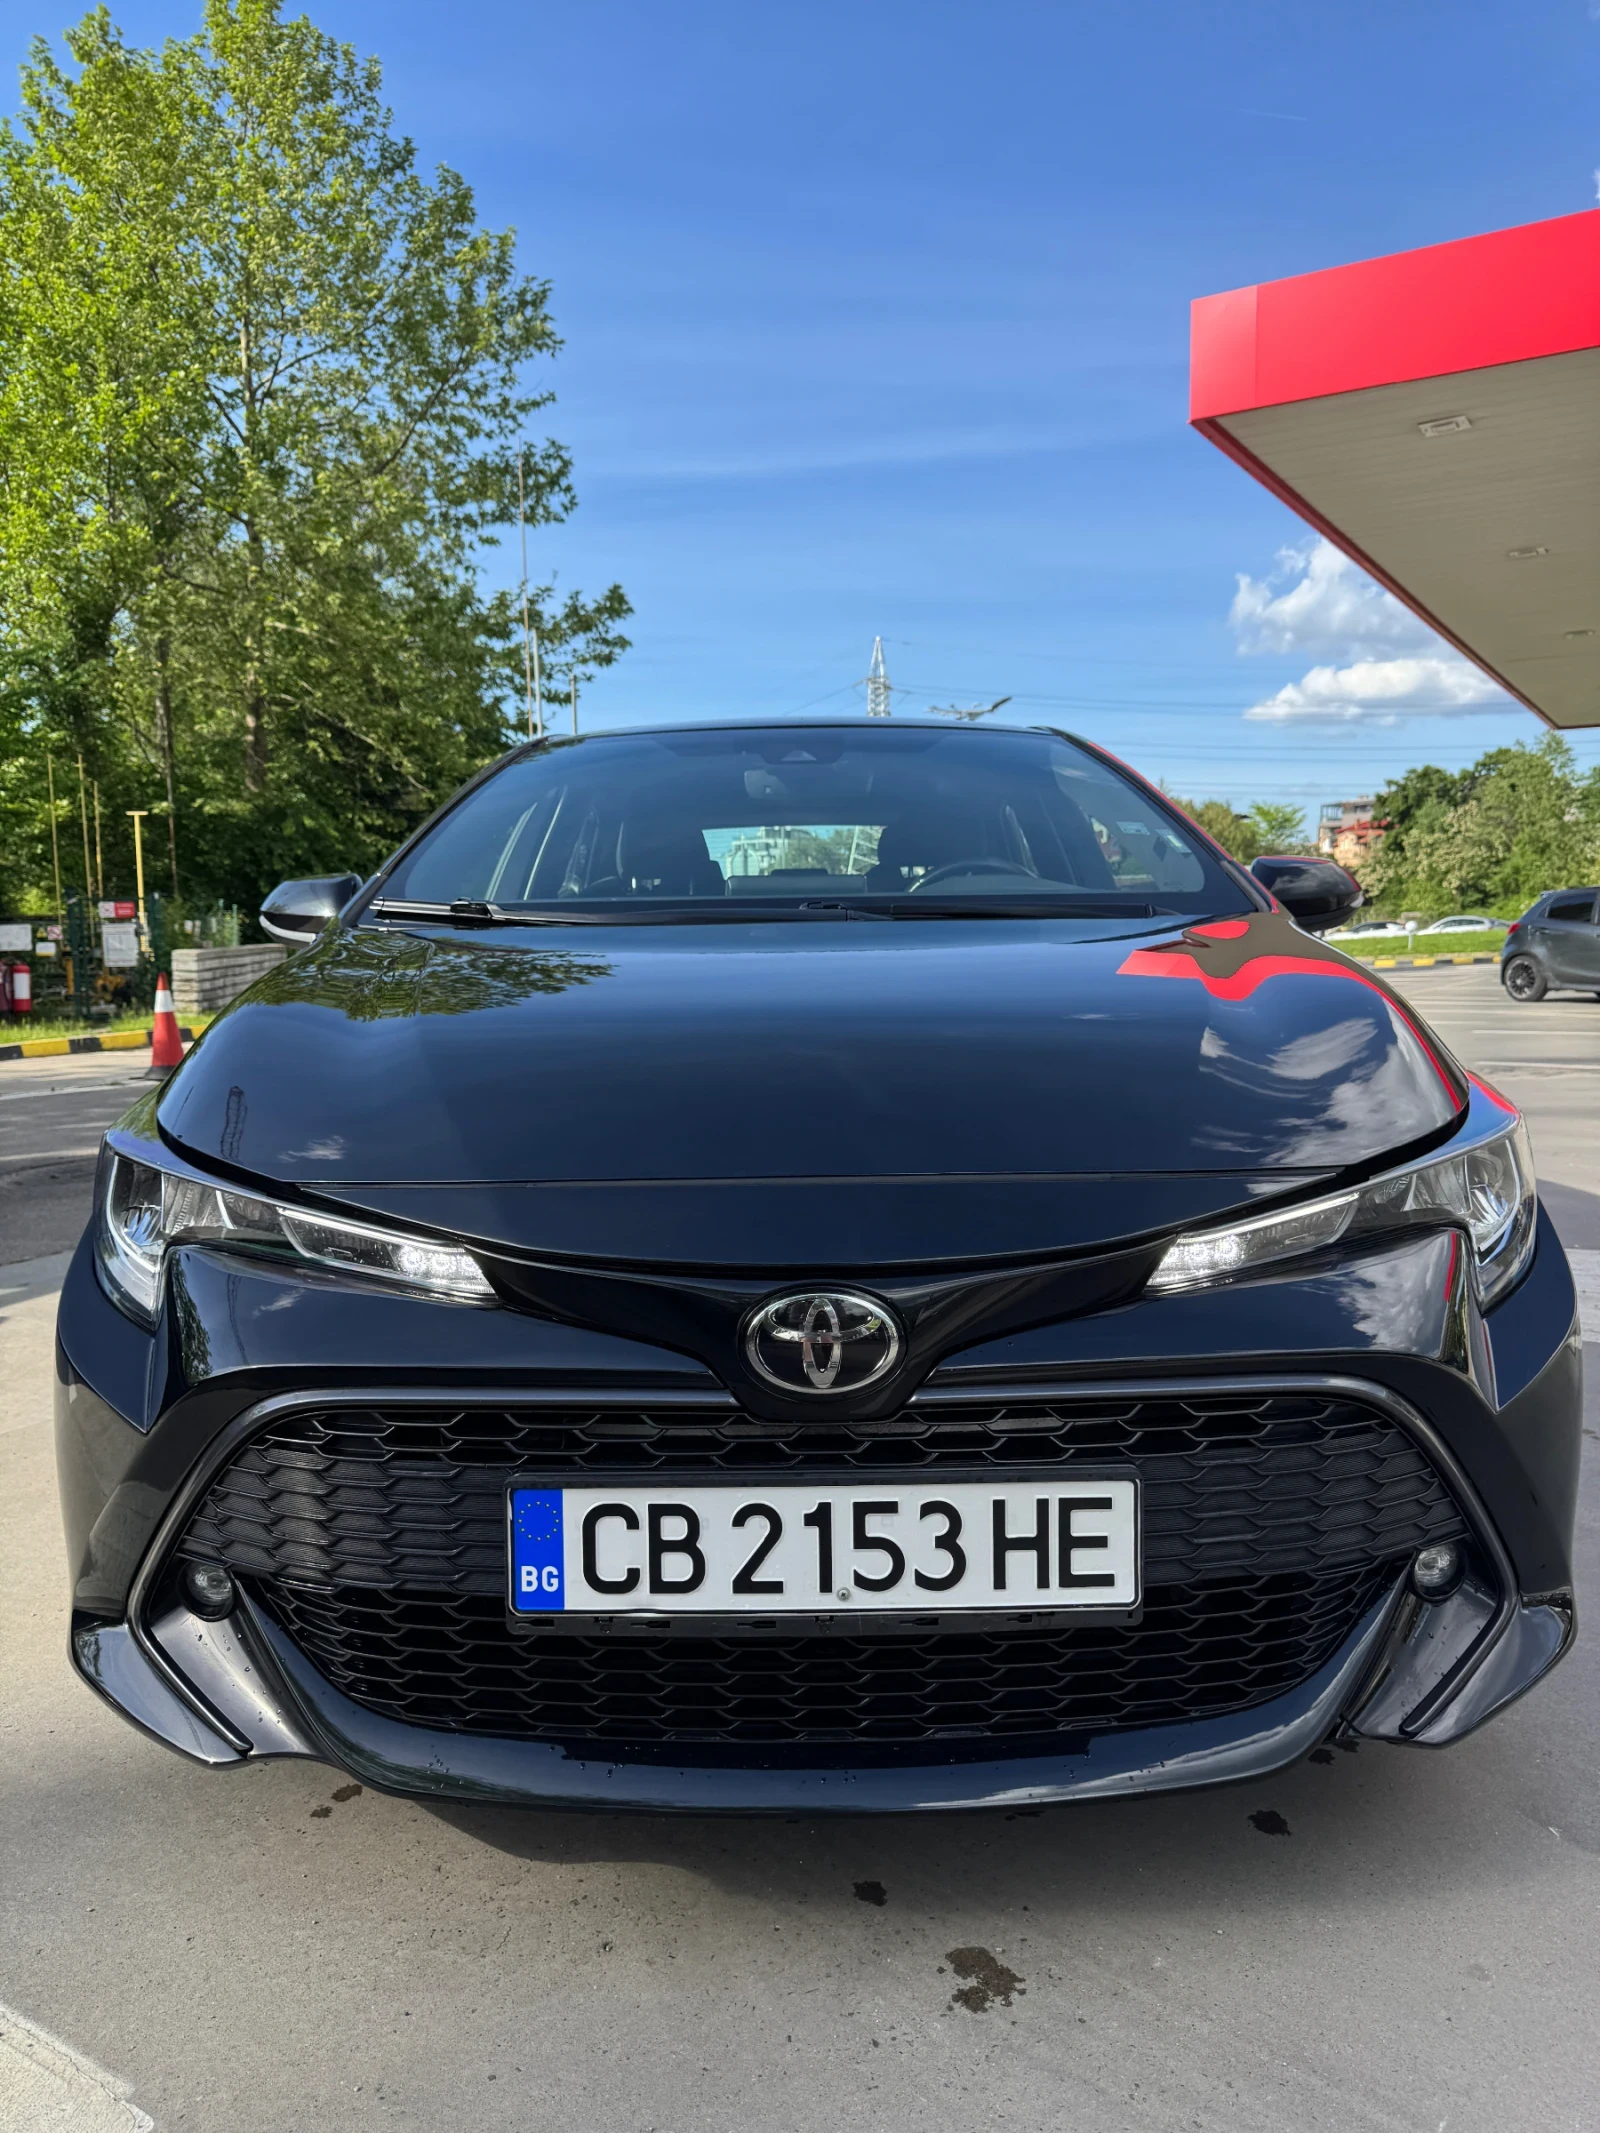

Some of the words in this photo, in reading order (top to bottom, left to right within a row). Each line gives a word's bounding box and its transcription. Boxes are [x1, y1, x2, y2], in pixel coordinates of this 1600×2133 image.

[582, 1502, 706, 1595] CB
[731, 1500, 967, 1595] 2153
[991, 1497, 1116, 1591] HE
[520, 1565, 560, 1592] BG
